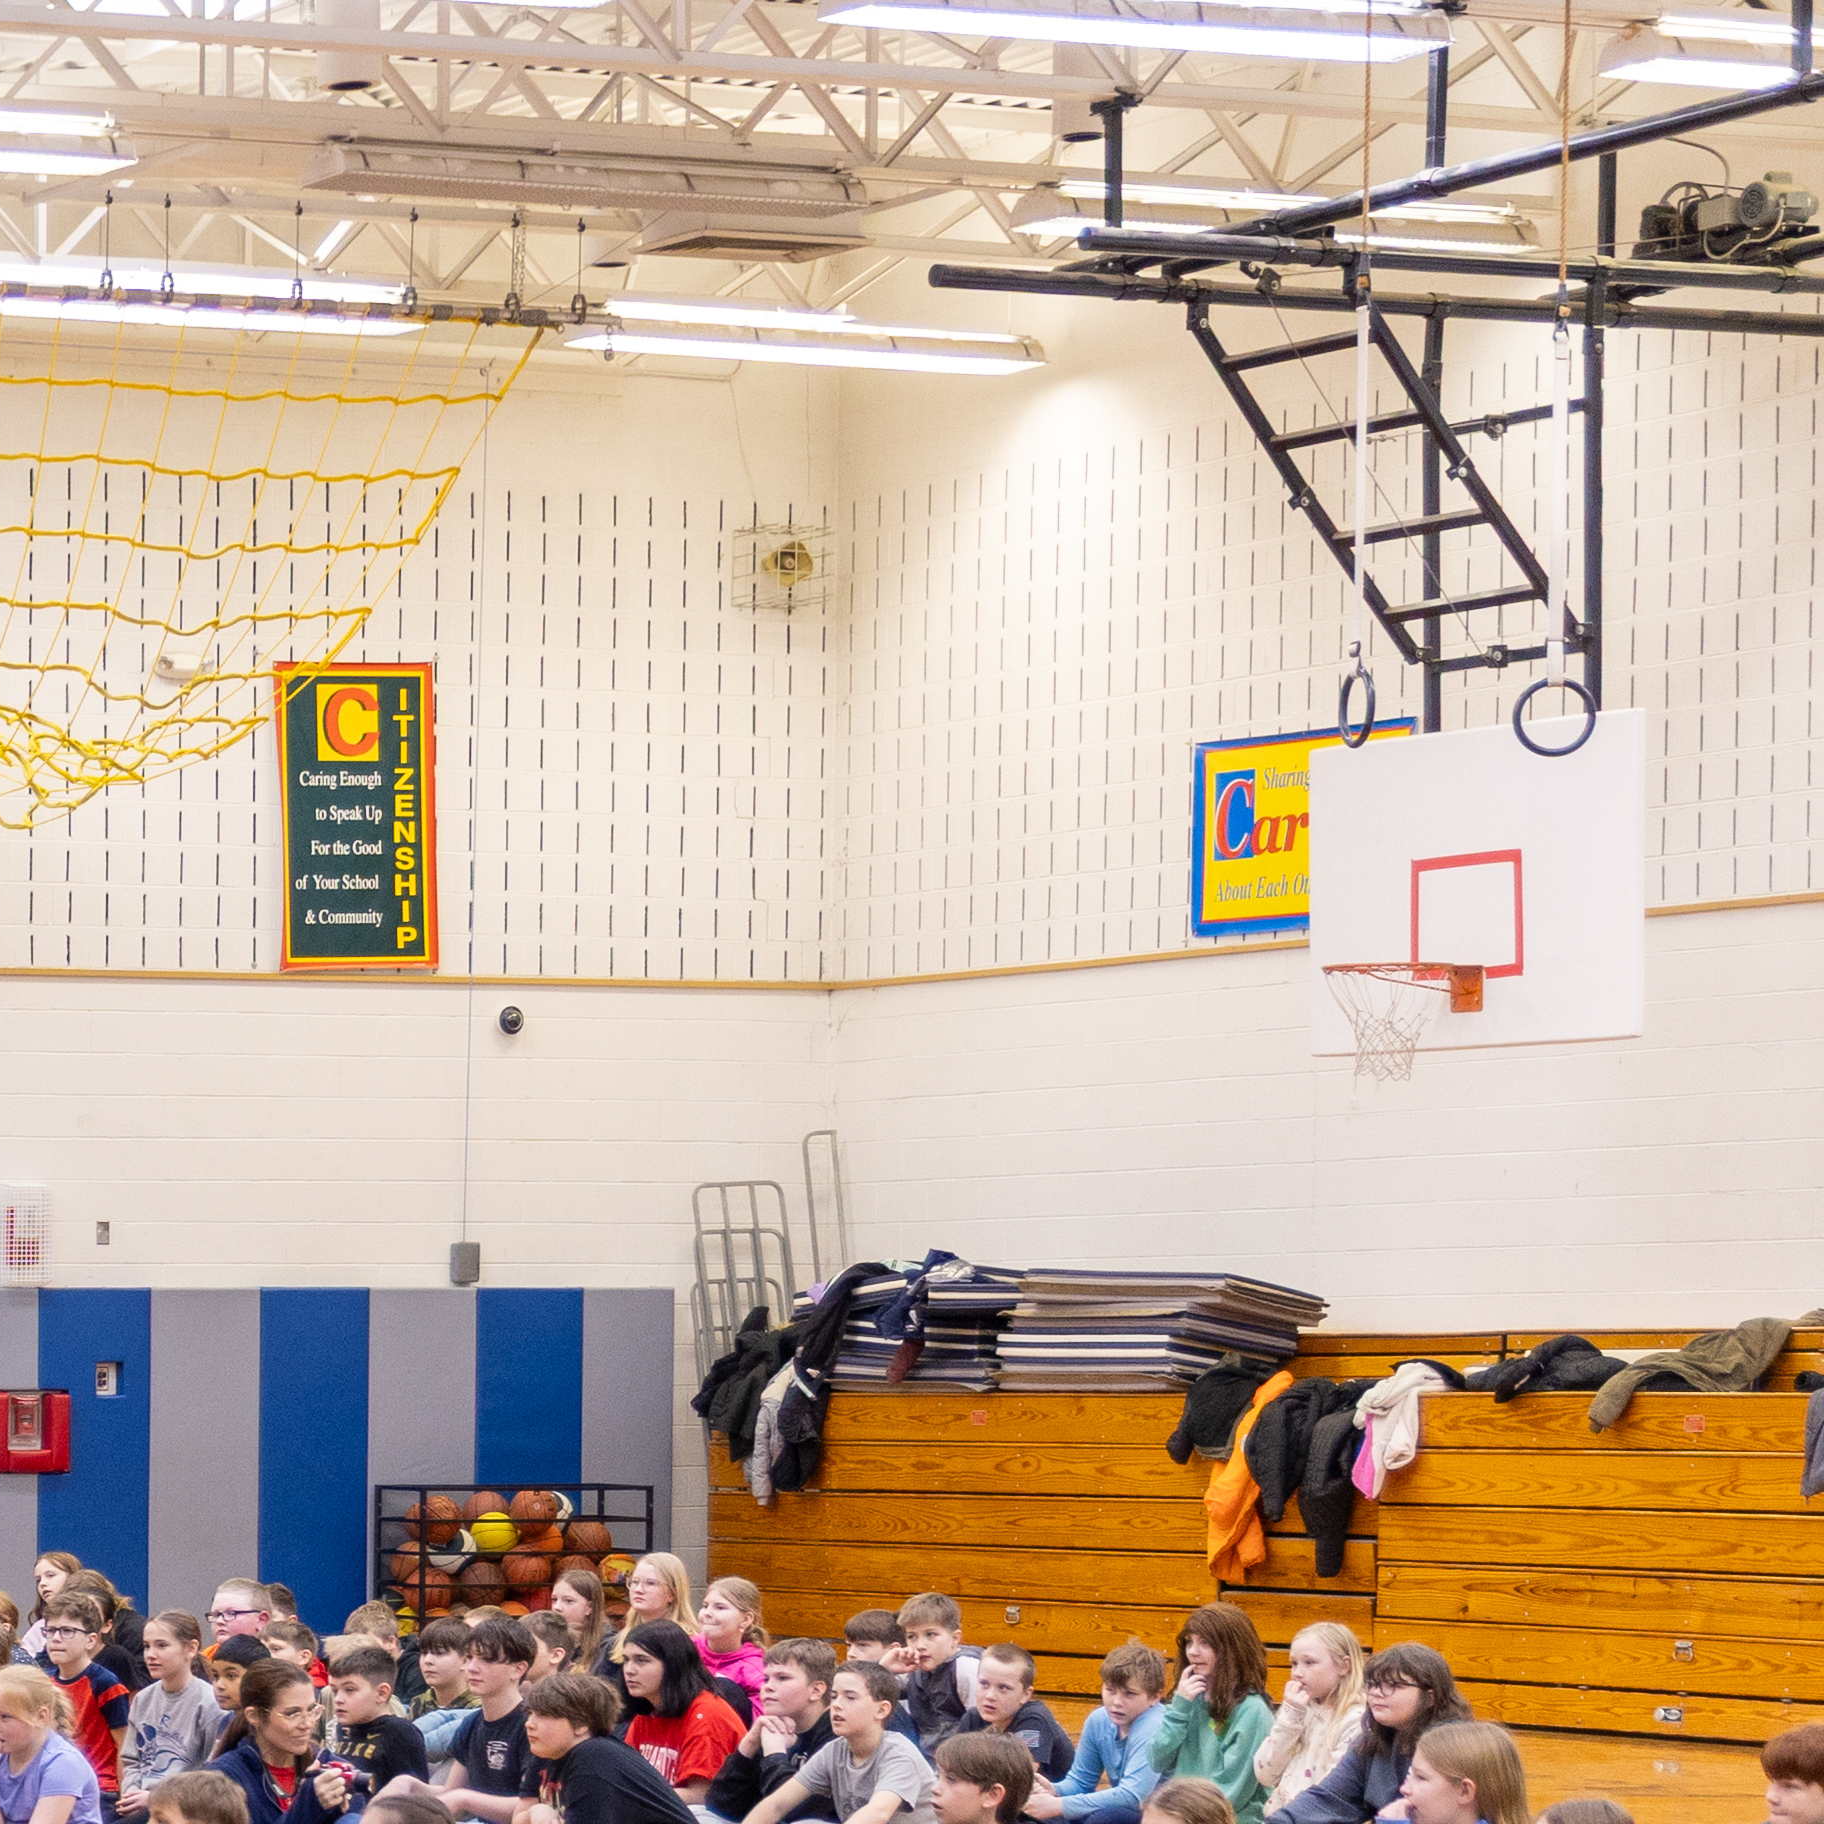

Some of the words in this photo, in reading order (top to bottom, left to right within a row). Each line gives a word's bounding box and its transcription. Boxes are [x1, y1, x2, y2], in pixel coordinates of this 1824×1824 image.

[300, 771, 337, 788] Caring
[340, 771, 382, 789] Enough
[316, 806, 327, 820] to
[329, 806, 362, 824] Speak
[365, 806, 382, 824] Up
[311, 841, 330, 855] For
[332, 841, 350, 855] the
[352, 841, 382, 855] Good
[295, 874, 308, 890] of
[313, 874, 340, 890] Your
[342, 874, 379, 890] School
[1213, 878, 1252, 902] About
[1256, 874, 1289, 898] Each
[1293, 872, 1310, 896] Ot
[305, 910, 316, 924] &
[318, 909, 383, 927] Community
